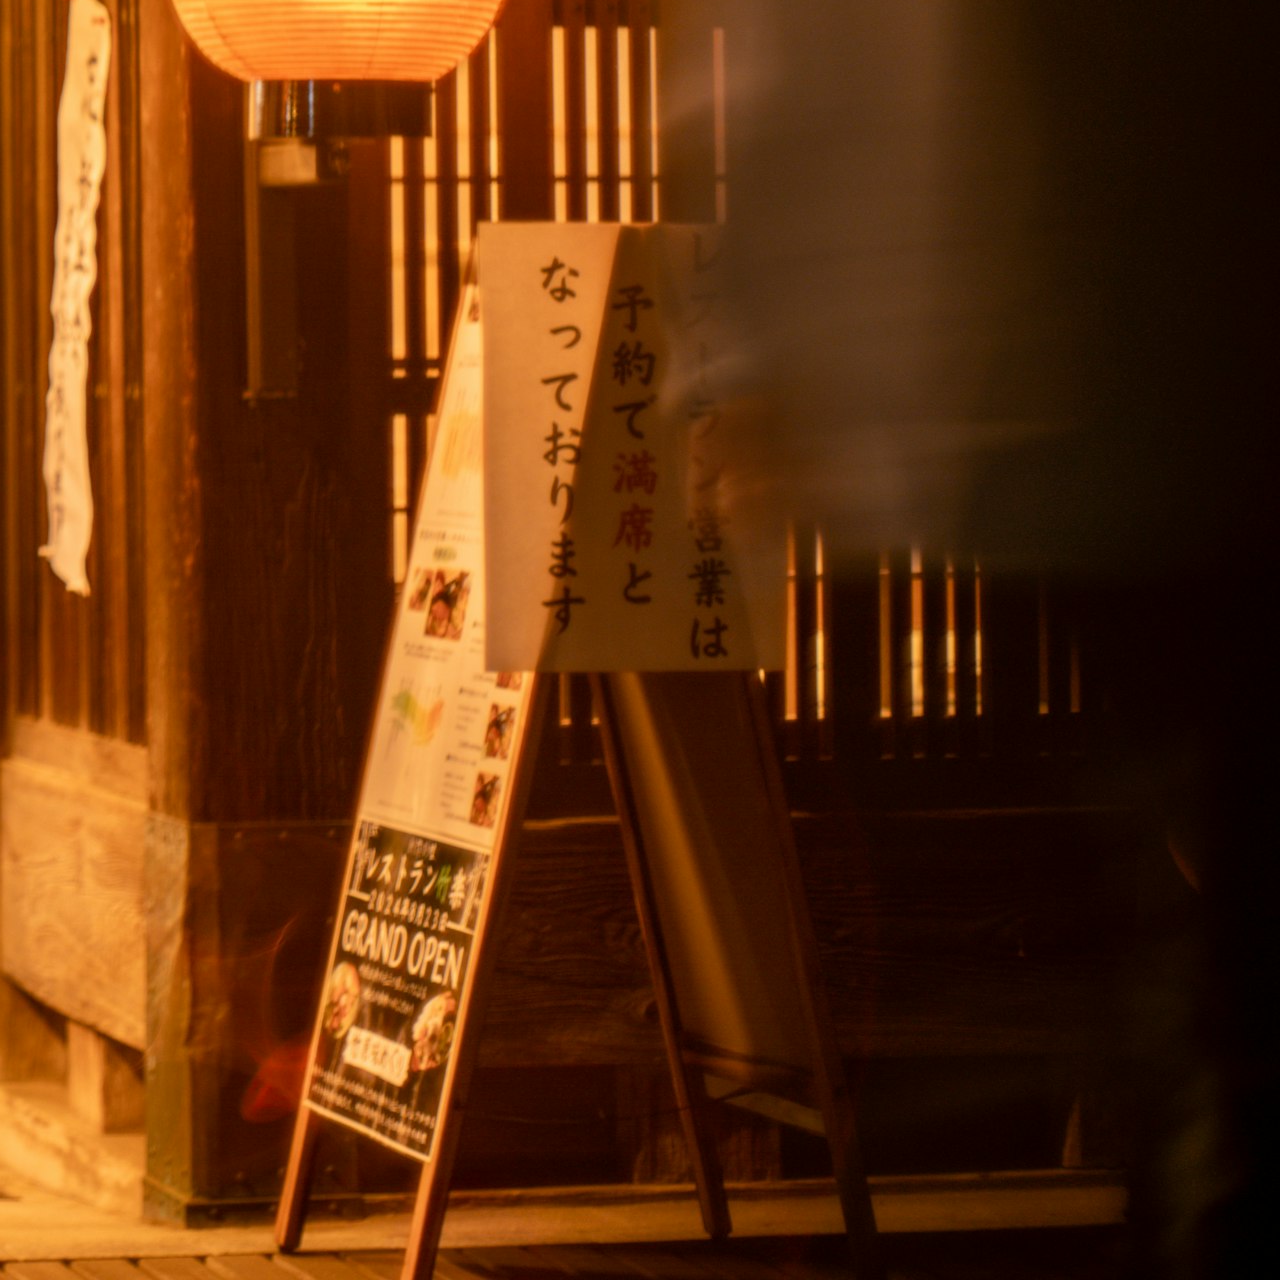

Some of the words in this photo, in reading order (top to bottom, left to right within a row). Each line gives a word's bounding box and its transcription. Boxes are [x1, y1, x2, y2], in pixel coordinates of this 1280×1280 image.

[539, 255, 587, 637] なっております
[610, 283, 658, 606] 予約で満席と
[341, 909, 408, 969] GRAND
[407, 930, 465, 990] OPEN
